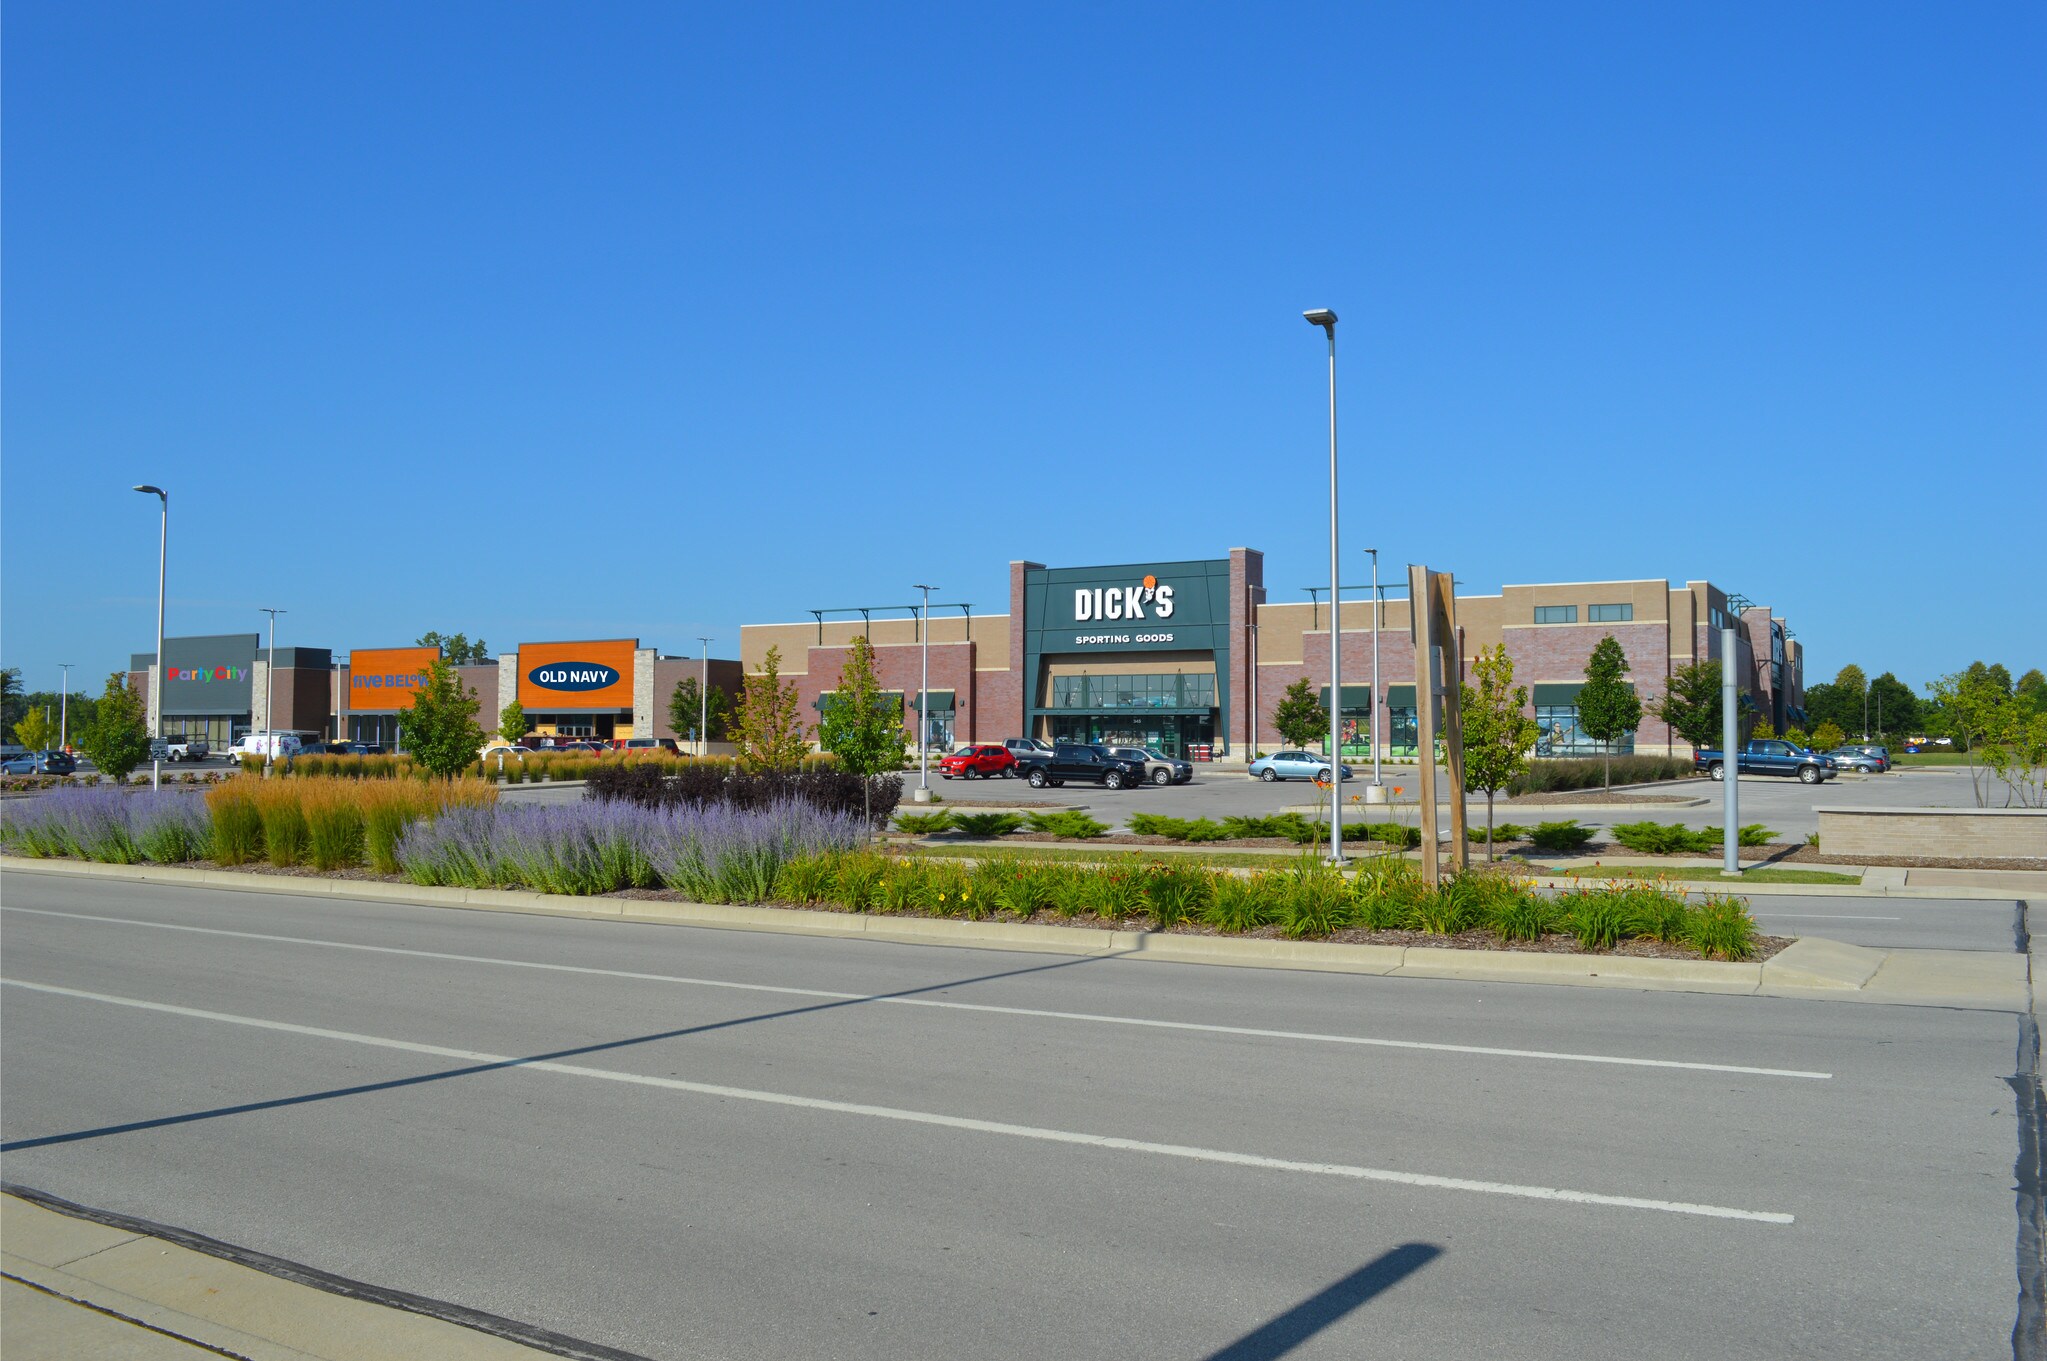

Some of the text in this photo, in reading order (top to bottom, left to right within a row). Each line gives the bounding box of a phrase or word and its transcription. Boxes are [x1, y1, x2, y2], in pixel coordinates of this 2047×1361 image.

[1075, 578, 1173, 620] DICK'S
[1075, 633, 1174, 644] SPORTING GOODS
[168, 665, 248, 683] Party City
[539, 670, 609, 683] OLD NAVY
[353, 674, 382, 688] five
[153, 750, 167, 759] 25
